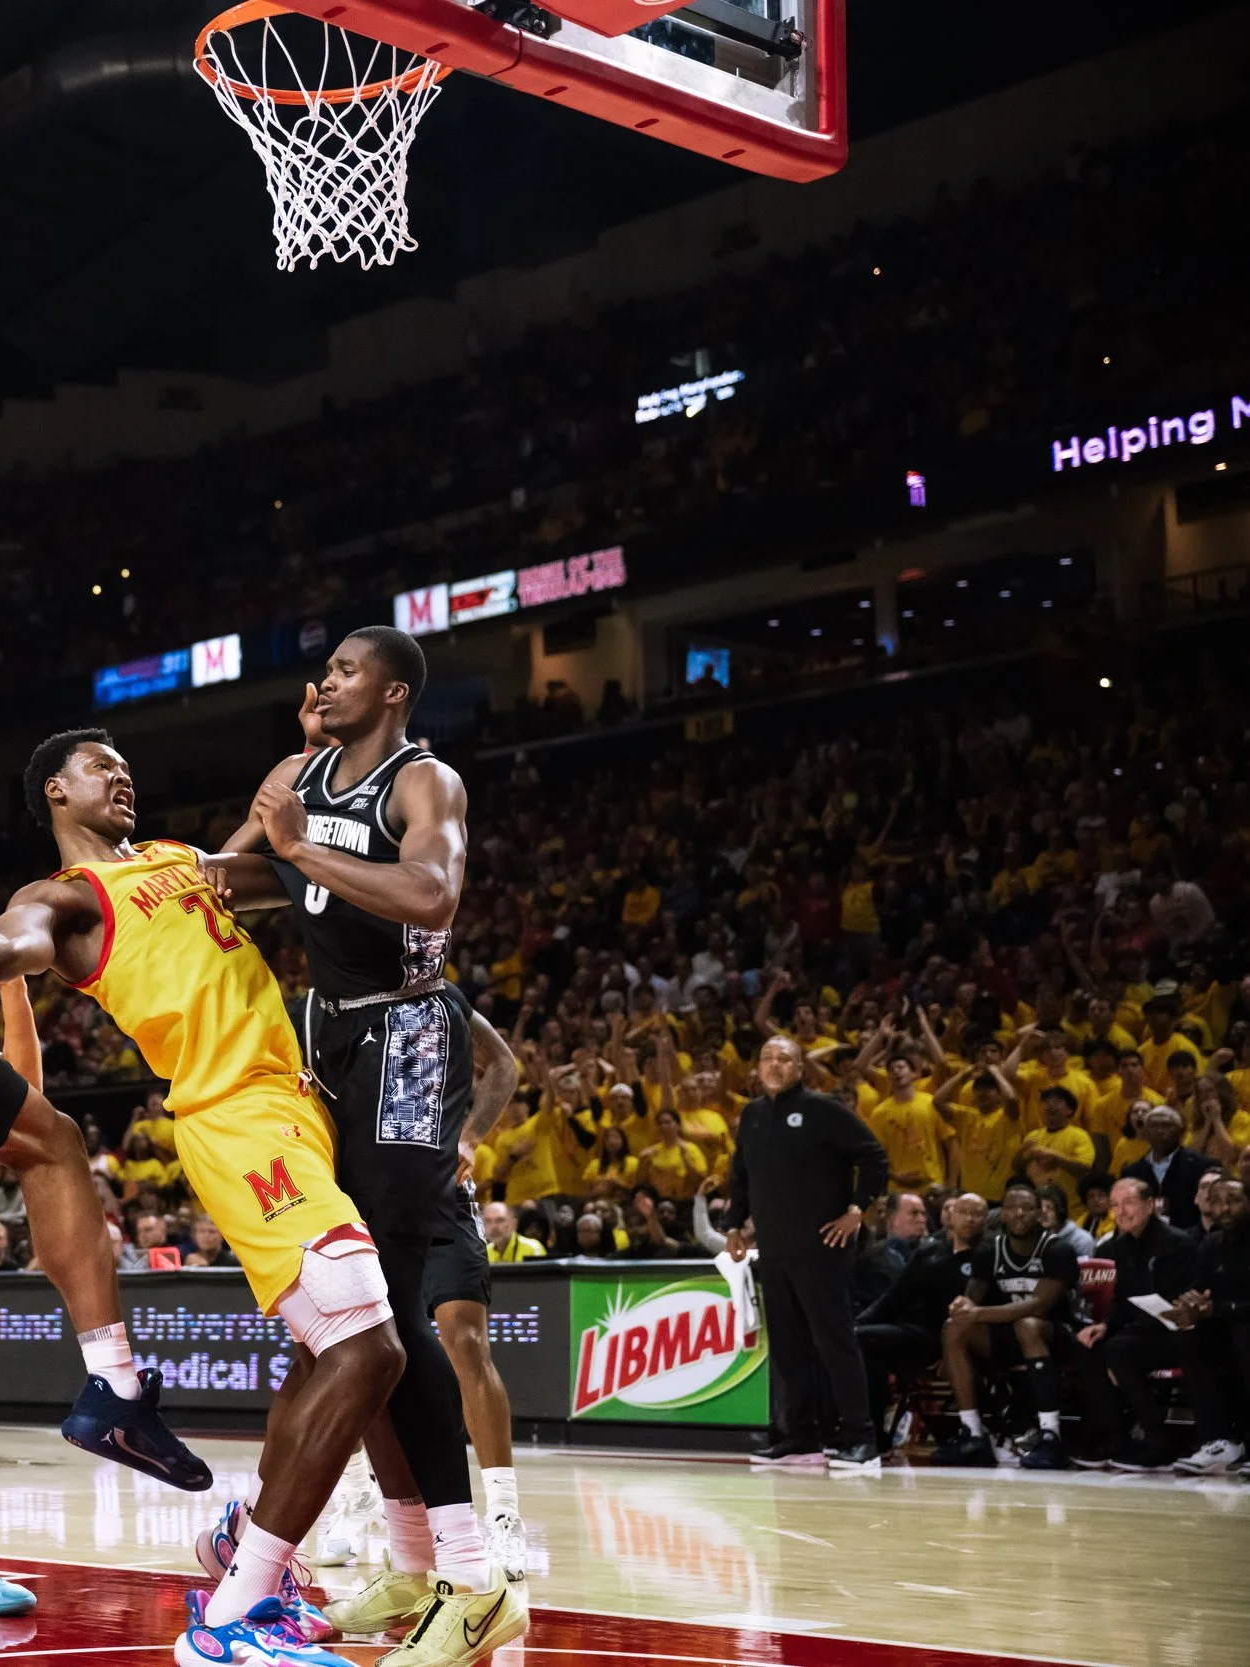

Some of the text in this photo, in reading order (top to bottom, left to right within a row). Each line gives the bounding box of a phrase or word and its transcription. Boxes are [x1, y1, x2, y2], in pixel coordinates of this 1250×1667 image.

[1052, 408, 1214, 472] Helping
[129, 865, 208, 921] MARYL
[243, 1155, 304, 1217] M
